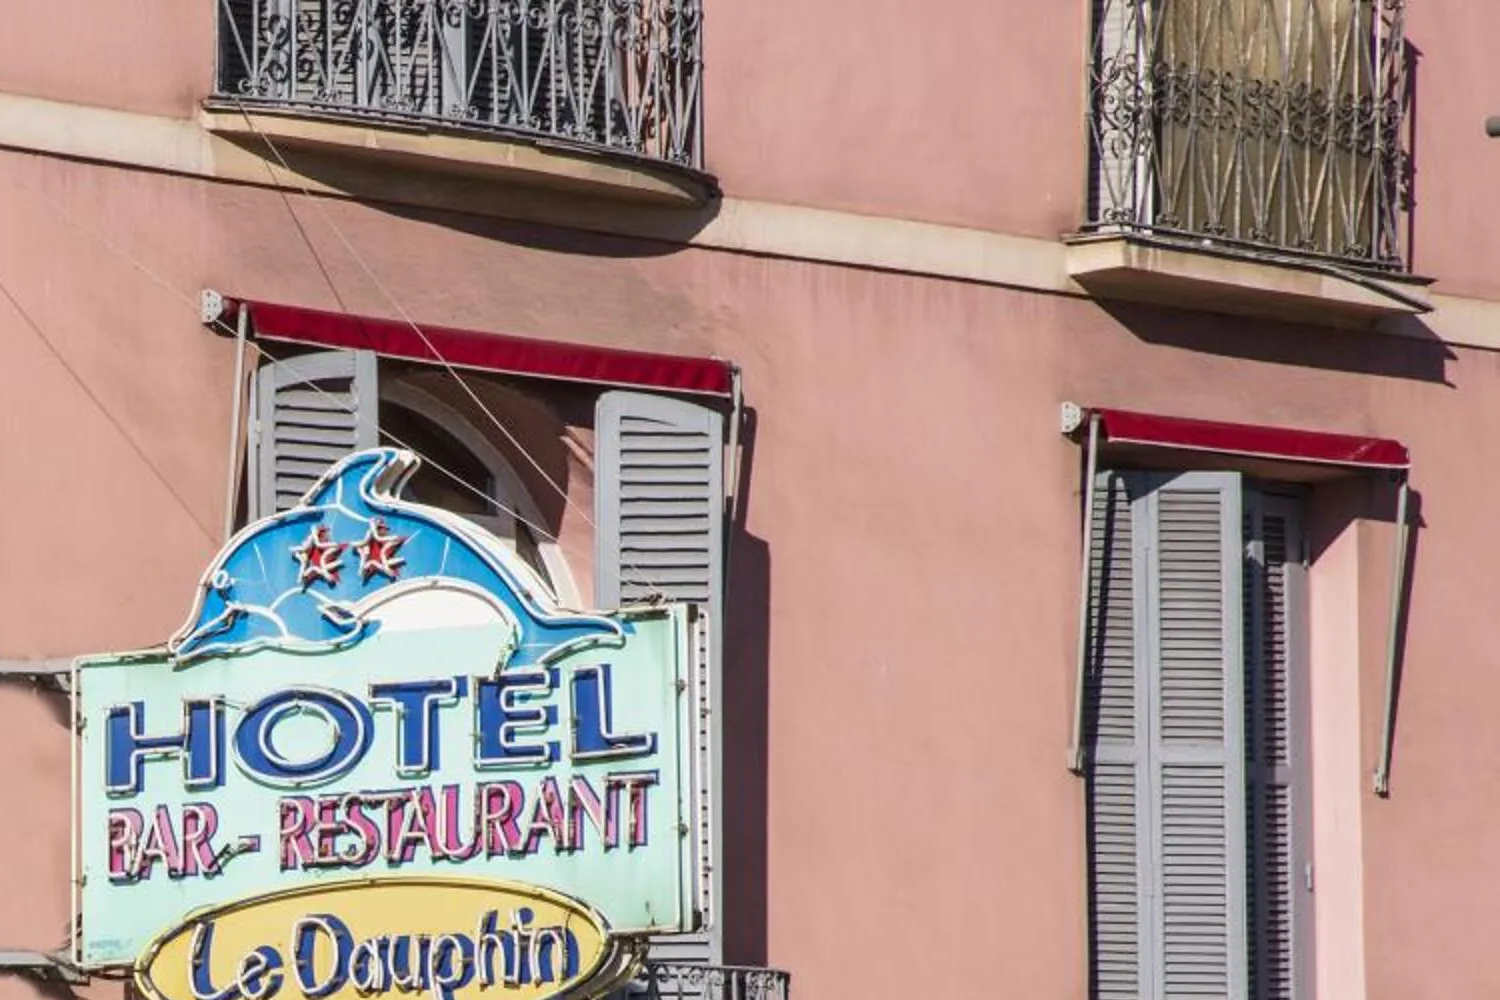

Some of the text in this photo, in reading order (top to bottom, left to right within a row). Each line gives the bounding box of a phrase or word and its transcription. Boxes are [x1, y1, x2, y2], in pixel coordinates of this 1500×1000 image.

[103, 664, 659, 797] HOTEL
[108, 802, 220, 885] BAR
[278, 769, 660, 871] RESTAURANT
